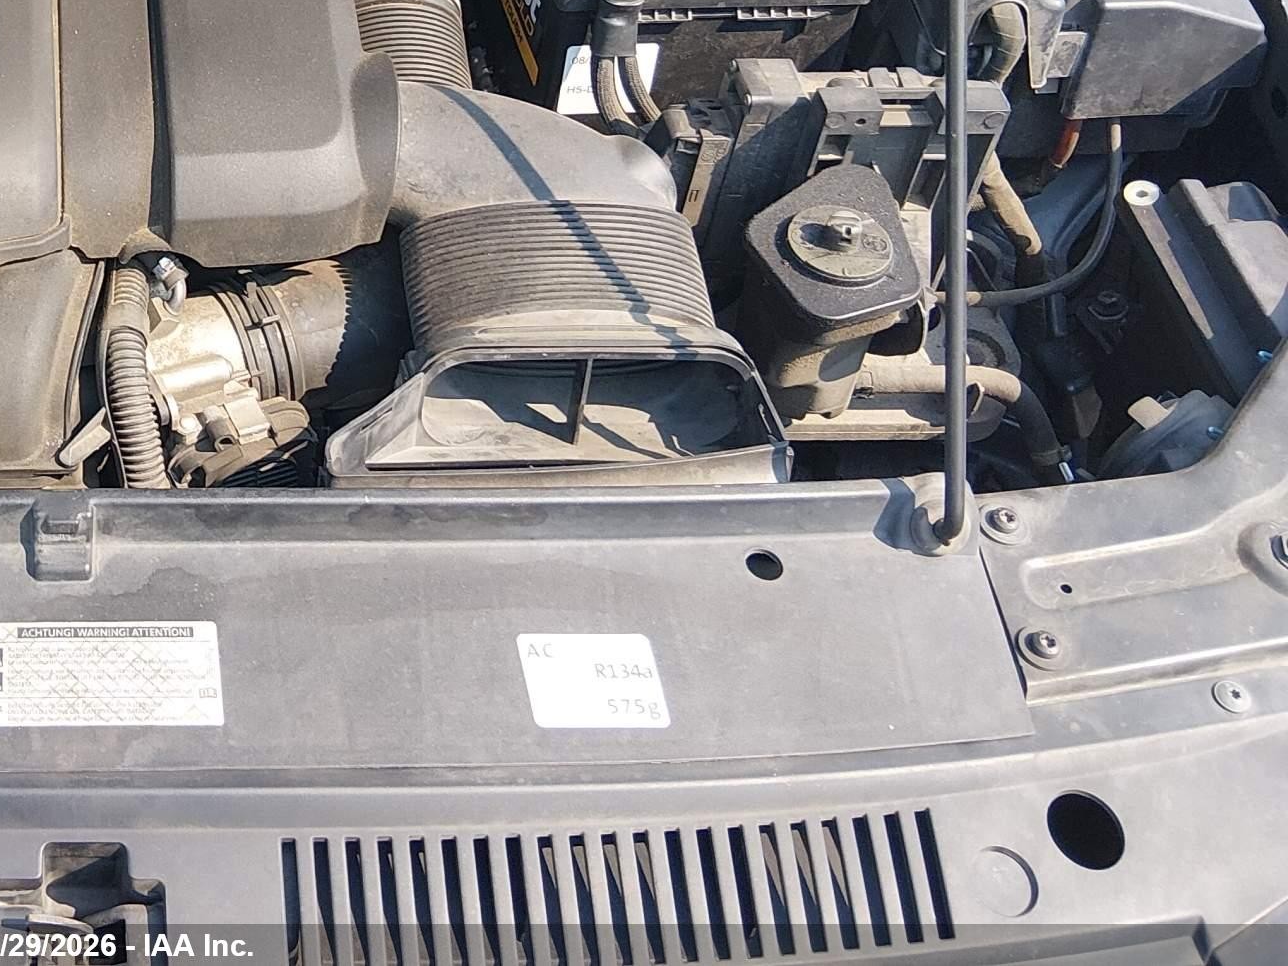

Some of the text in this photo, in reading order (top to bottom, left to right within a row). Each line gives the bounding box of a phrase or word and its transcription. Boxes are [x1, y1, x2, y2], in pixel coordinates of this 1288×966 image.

[21, 627, 190, 638] ACHTUNG! WARNING! ATTENTION!
[527, 643, 554, 658] AC
[594, 663, 653, 679] R134a
